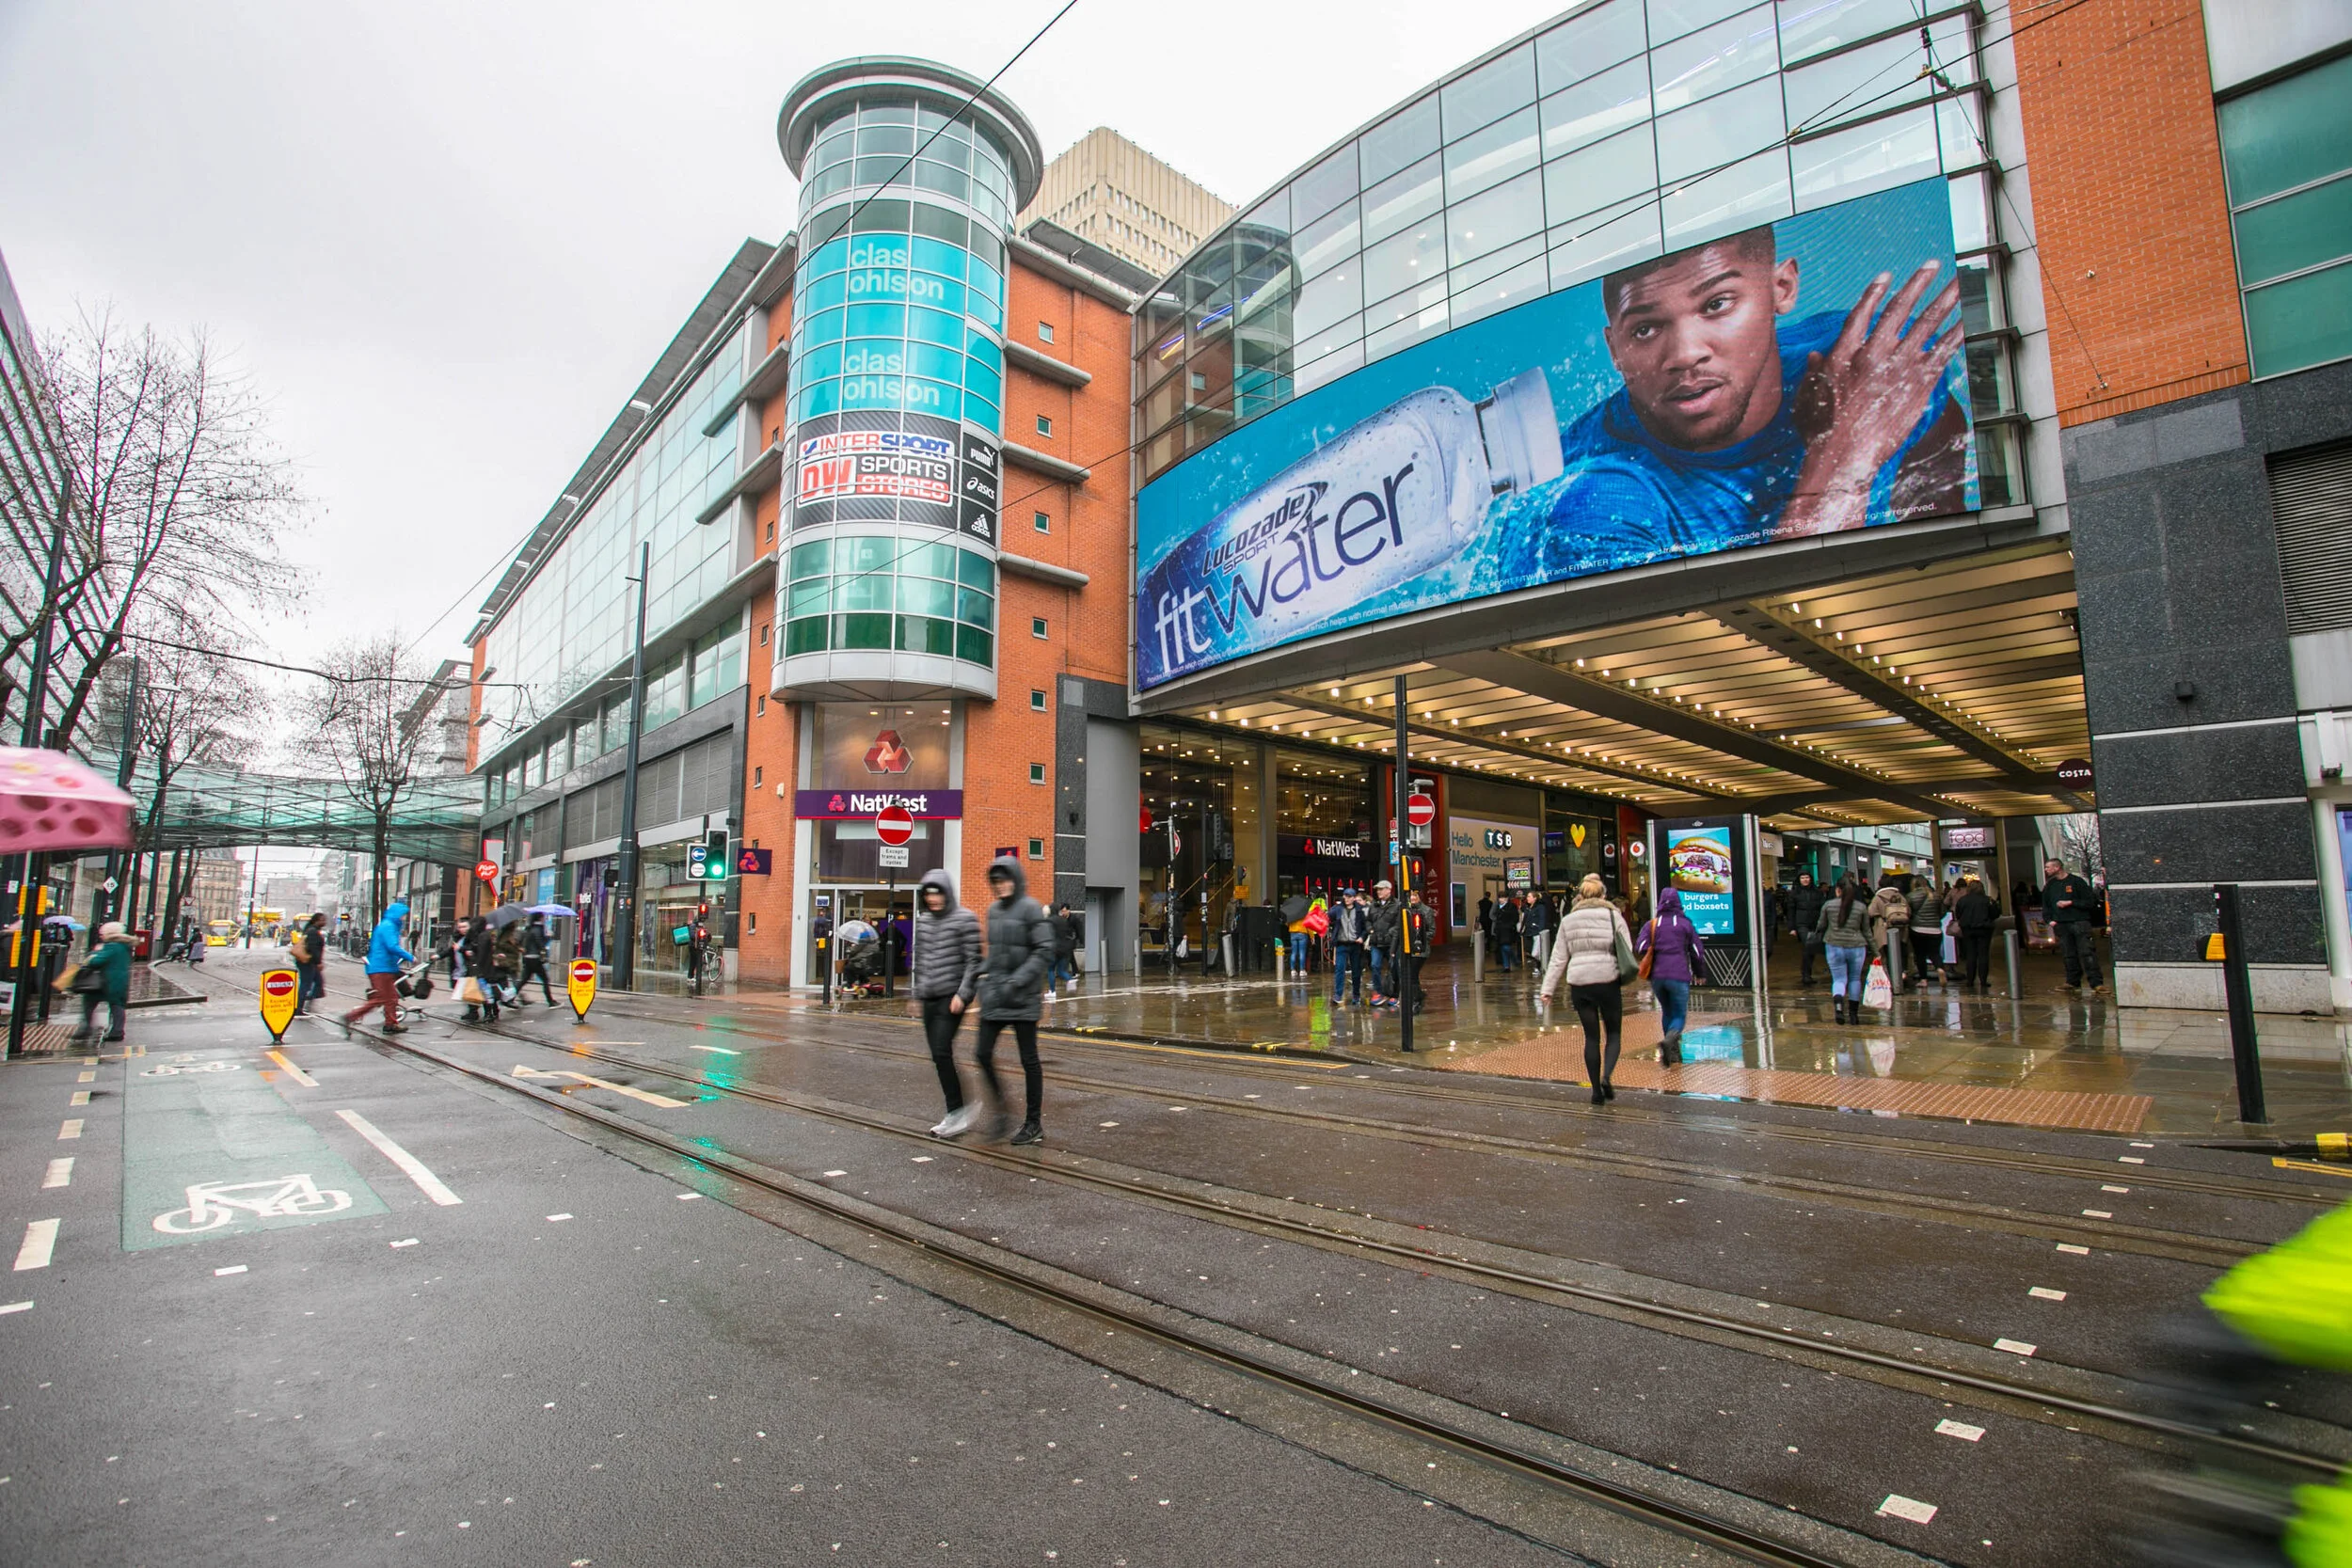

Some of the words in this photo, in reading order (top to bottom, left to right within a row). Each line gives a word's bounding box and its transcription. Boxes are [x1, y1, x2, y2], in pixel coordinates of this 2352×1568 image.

[850, 243, 907, 268] clas
[850, 268, 944, 300] ohlson
[845, 348, 902, 373] clas
[844, 374, 940, 406] ohlson
[820, 433, 950, 459] INTERSPORT
[802, 458, 852, 499] DW
[861, 455, 947, 481] SPORTS
[861, 474, 947, 500] STORES
[1223, 531, 1279, 576] SPORT
[1329, 615, 1347, 628] helps
[1348, 612, 1363, 623] with
[1363, 608, 1388, 620] normal
[1553, 566, 1567, 576] and
[1568, 559, 1610, 572] FITWATER
[1720, 531, 1761, 545] Lucozade
[1762, 525, 1793, 537] Ribena
[1851, 512, 1862, 522] All
[1891, 501, 1938, 516] reserved.
[2058, 768, 2091, 778] COSTA
[850, 794, 928, 813] NatWest
[1317, 839, 1360, 858] NatWest
[1453, 831, 1474, 847] Hello
[1487, 832, 1512, 847] TSB
[1684, 893, 1719, 903] burgers
[1693, 902, 1729, 911] boxsets
